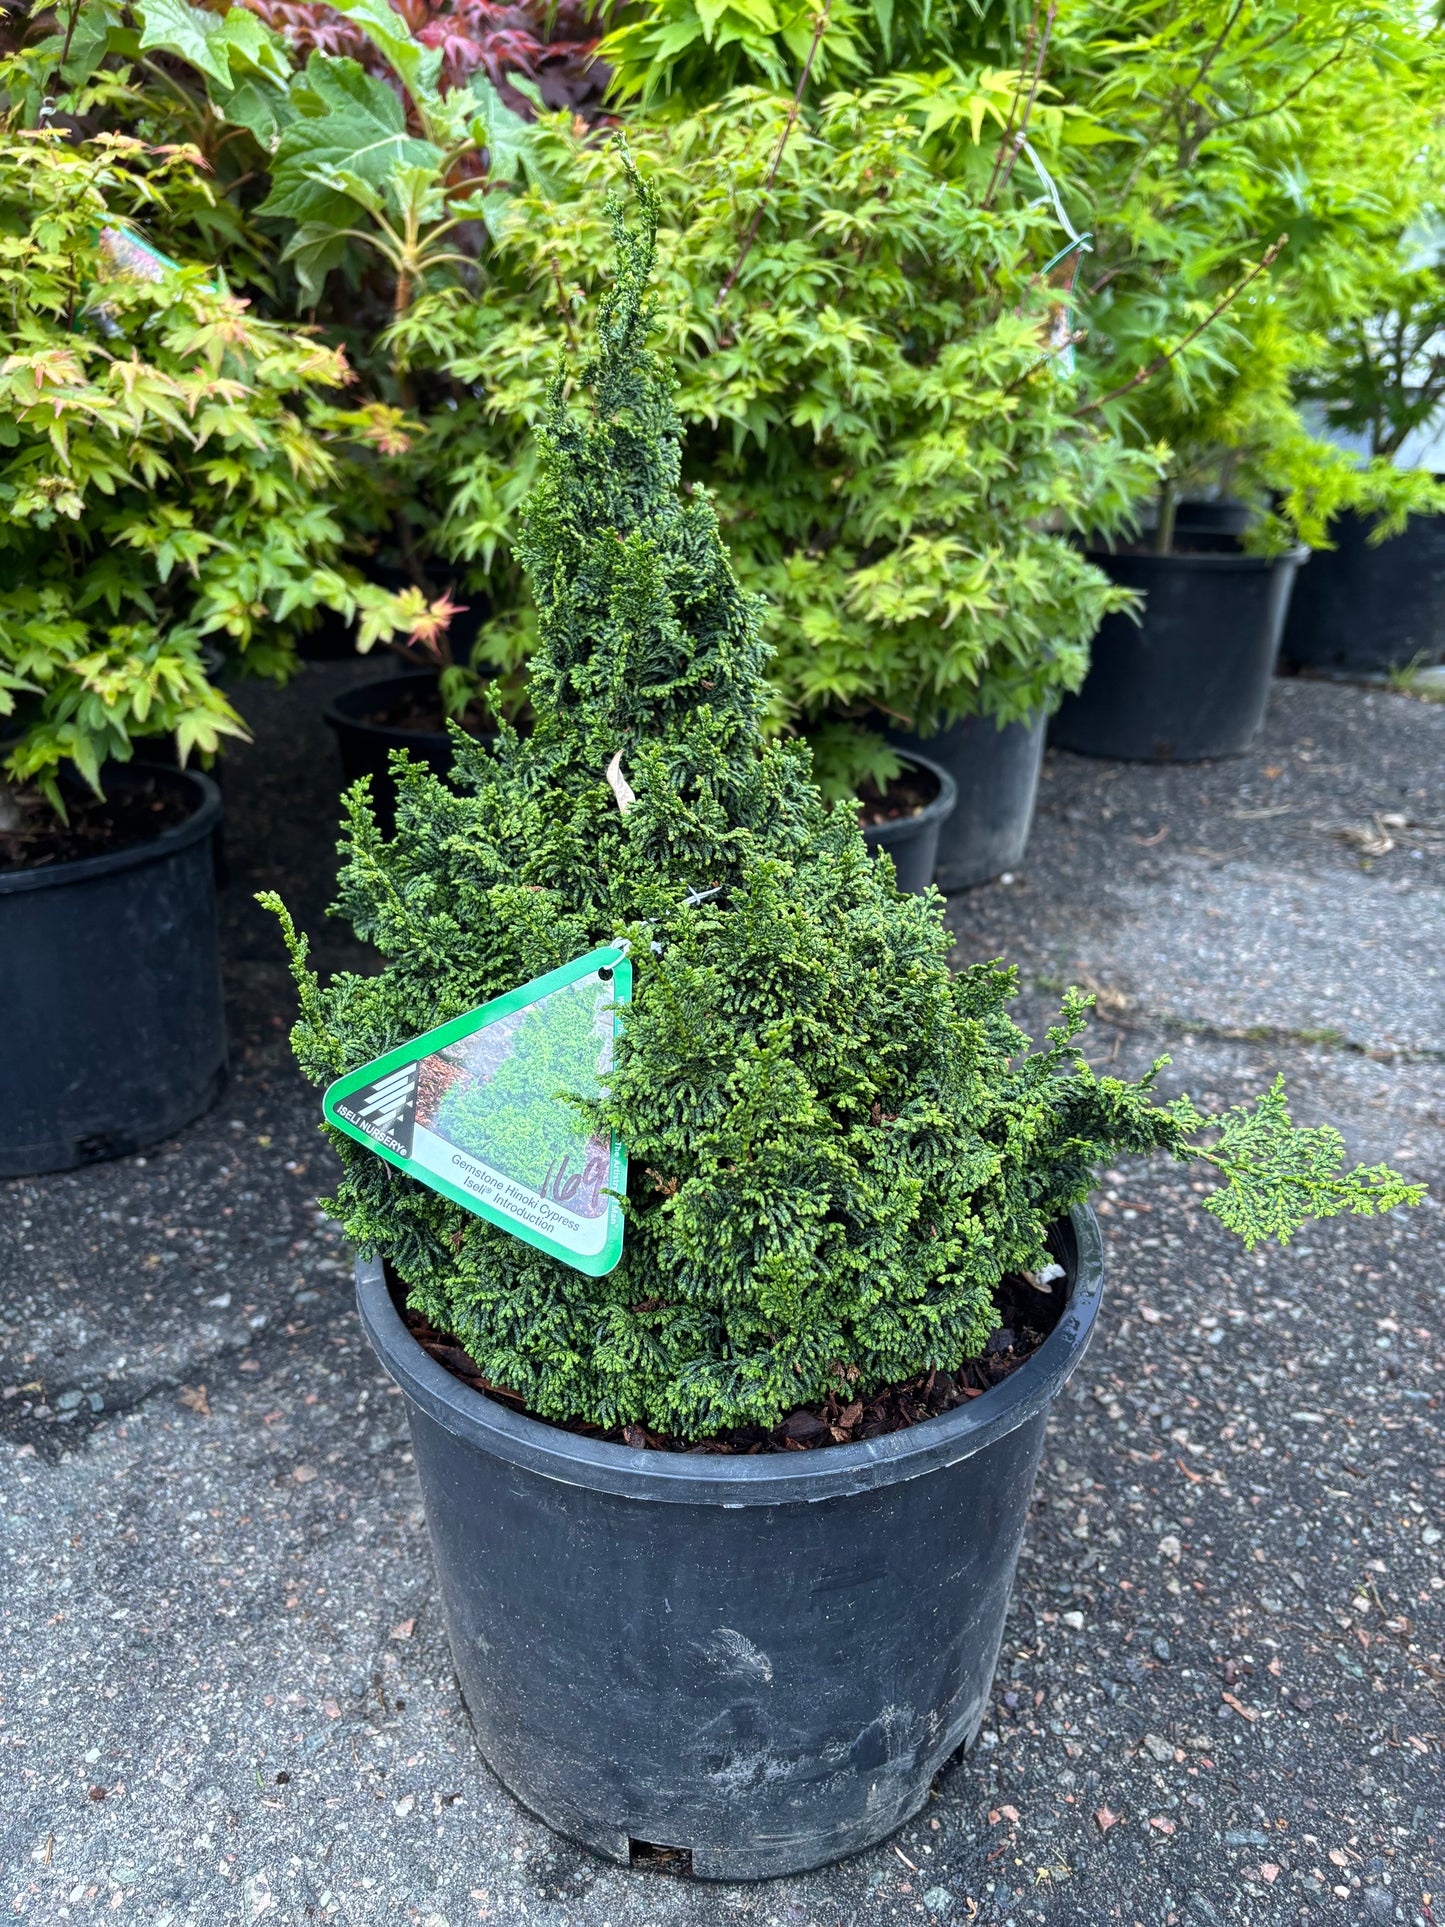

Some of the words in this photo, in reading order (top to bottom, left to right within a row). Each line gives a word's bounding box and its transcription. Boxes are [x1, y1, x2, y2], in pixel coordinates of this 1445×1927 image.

[338, 1105, 360, 1125] ISELI
[360, 1120, 407, 1155] NURSERY®
[614, 1142, 622, 1157] The
[451, 1154, 503, 1190] Gemstone
[505, 1184, 540, 1209] Hinoki
[539, 1204, 580, 1232] Cypress
[540, 1154, 609, 1208] 169
[611, 1159, 621, 1191] Artistry
[464, 1176, 493, 1195] Iseli®
[493, 1193, 554, 1233] Introduction
